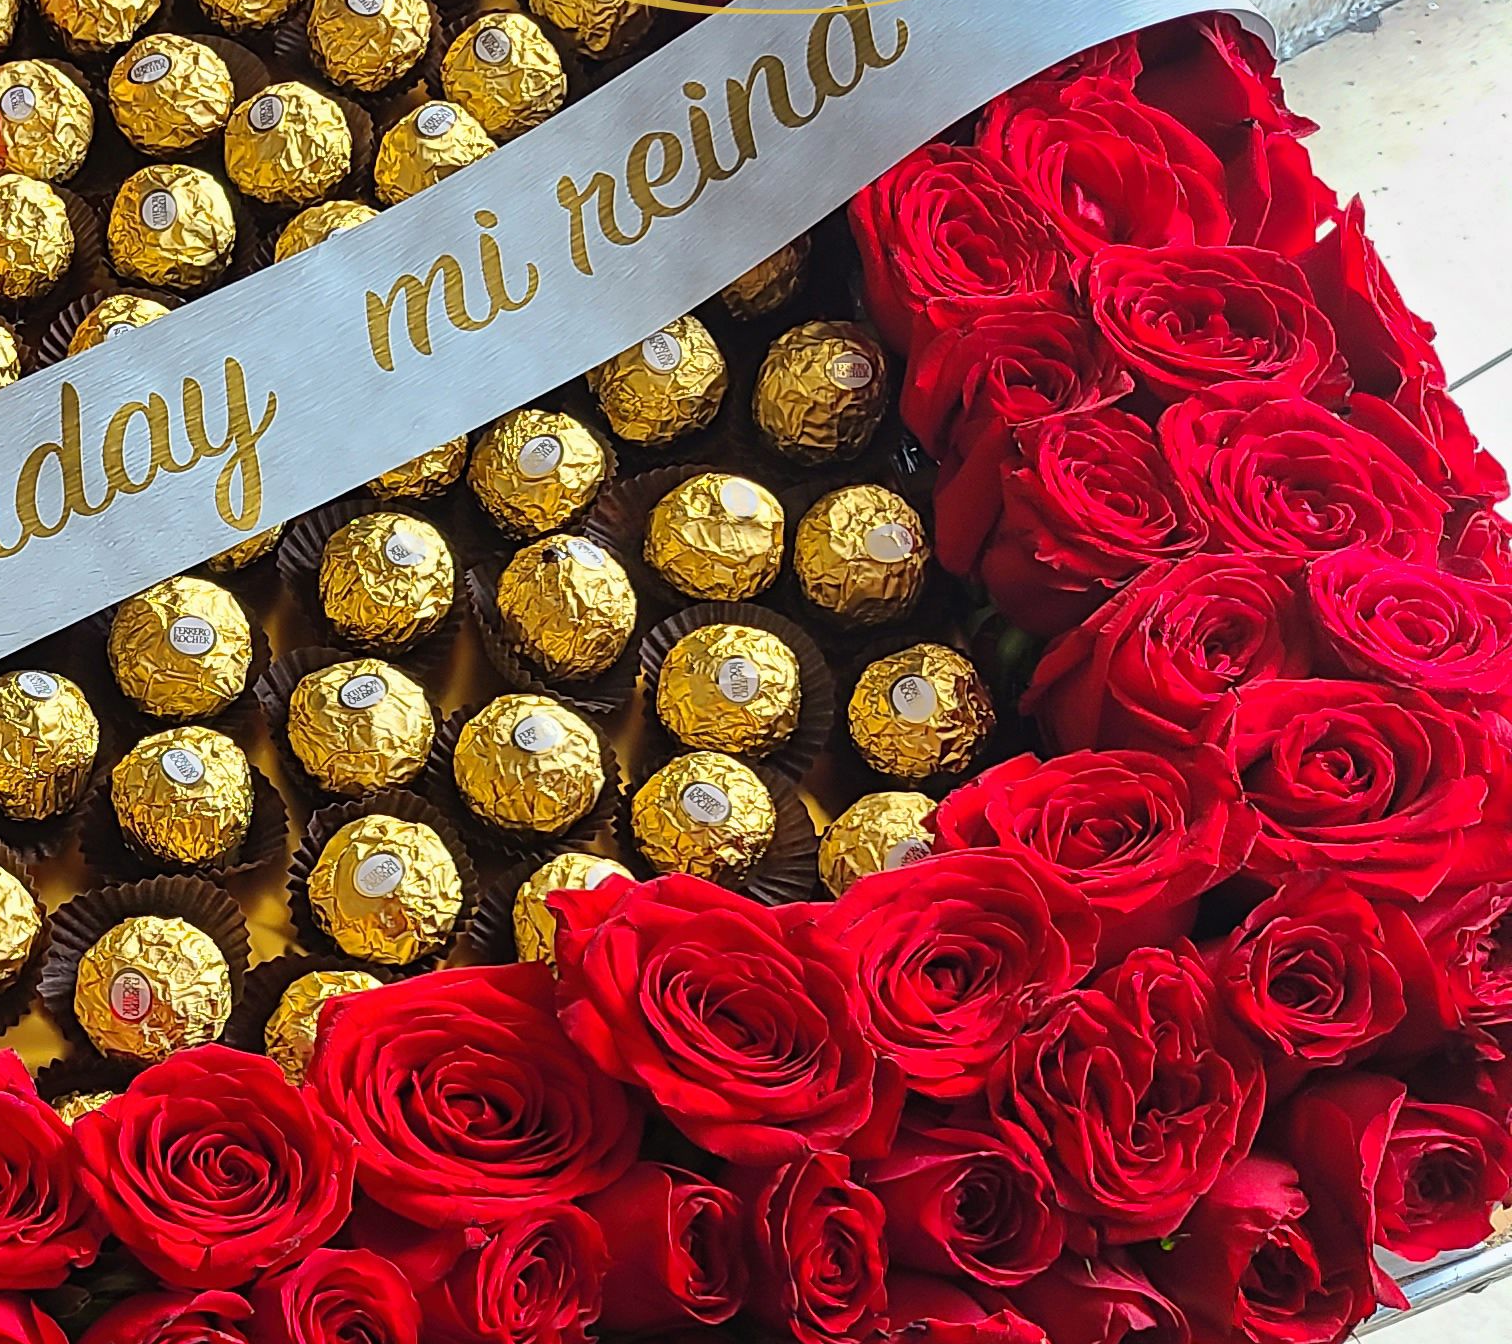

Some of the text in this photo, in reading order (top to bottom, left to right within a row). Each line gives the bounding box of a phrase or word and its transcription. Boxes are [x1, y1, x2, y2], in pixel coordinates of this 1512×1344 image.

[364, 207, 540, 373] mi
[173, 626, 210, 637] FERRERO
[173, 635, 211, 645] ROCHER
[344, 679, 377, 699] ROCHER
[349, 684, 382, 705] FERRERO
[168, 754, 191, 780] ROCHER
[687, 794, 718, 819] ROCHE
[692, 787, 725, 813] FERRERO
[123, 976, 132, 1015] ROCHER
[132, 976, 140, 1016] FERRERO
